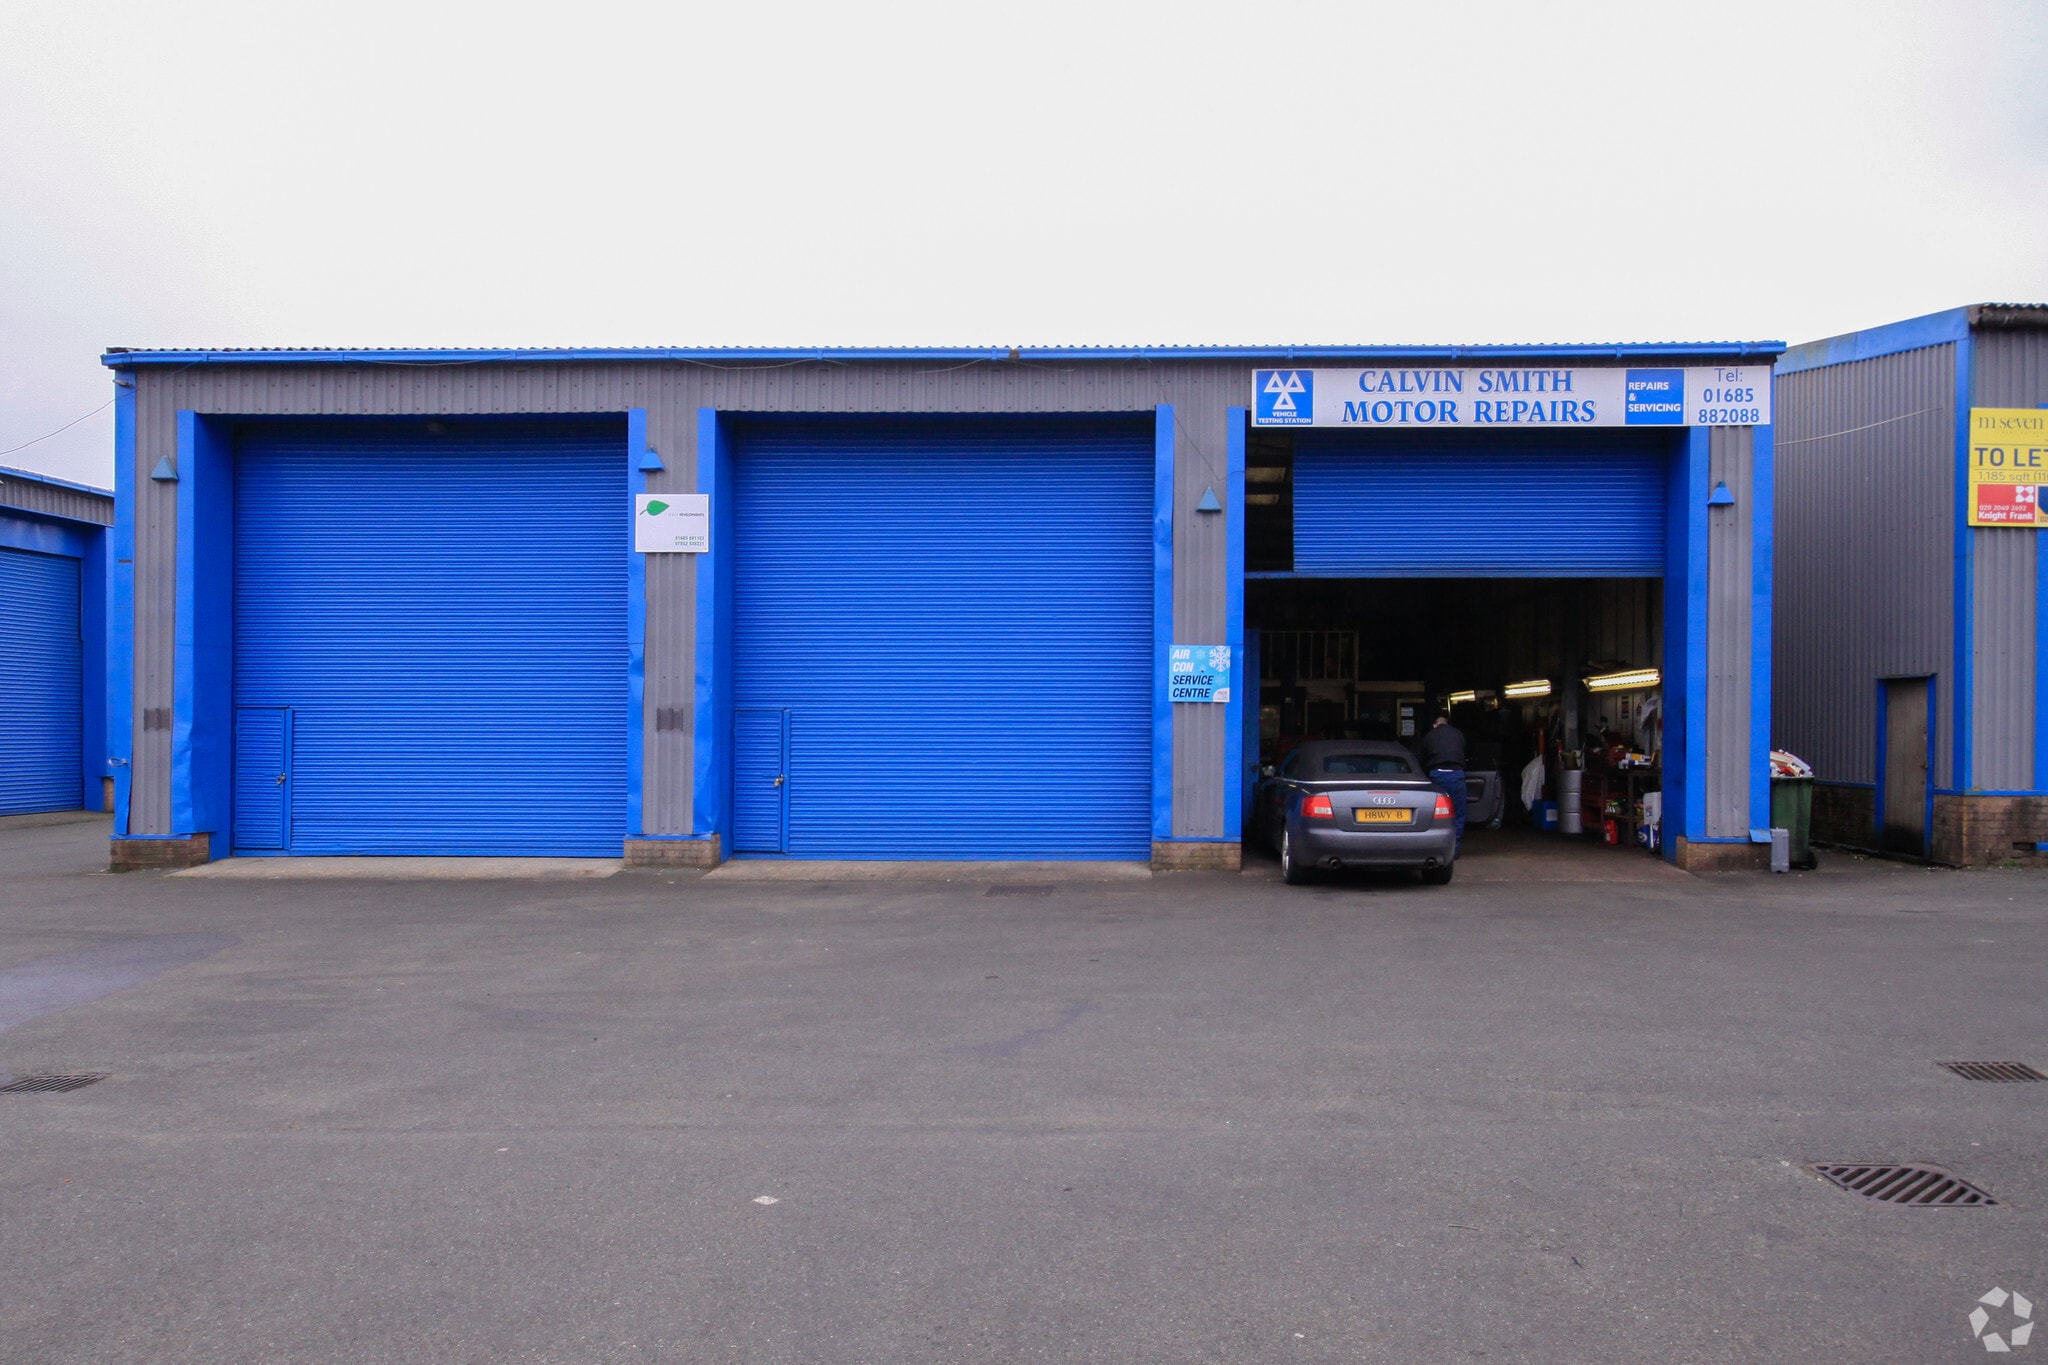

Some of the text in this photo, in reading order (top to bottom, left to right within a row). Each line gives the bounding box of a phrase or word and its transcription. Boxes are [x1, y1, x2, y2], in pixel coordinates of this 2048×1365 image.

[1714, 367, 1743, 383] Tel:
[1359, 370, 1574, 393] CALVIN SMITH
[1628, 381, 1669, 391] REPAIRS
[1628, 392, 1637, 402] &
[1703, 388, 1754, 403] 01685
[1341, 400, 1596, 423] MOTOR REPAIRS
[1628, 403, 1681, 412] SERVICING
[1698, 408, 1760, 423] 882088
[2000, 416, 2044, 430] seven
[1974, 447, 2005, 467] TO
[1978, 511, 2033, 522] Knight Frank
[1172, 649, 1190, 659] AIR
[1173, 662, 1194, 672] CON
[1172, 675, 1214, 685] SERVICE
[1172, 688, 1210, 698] CENTRE
